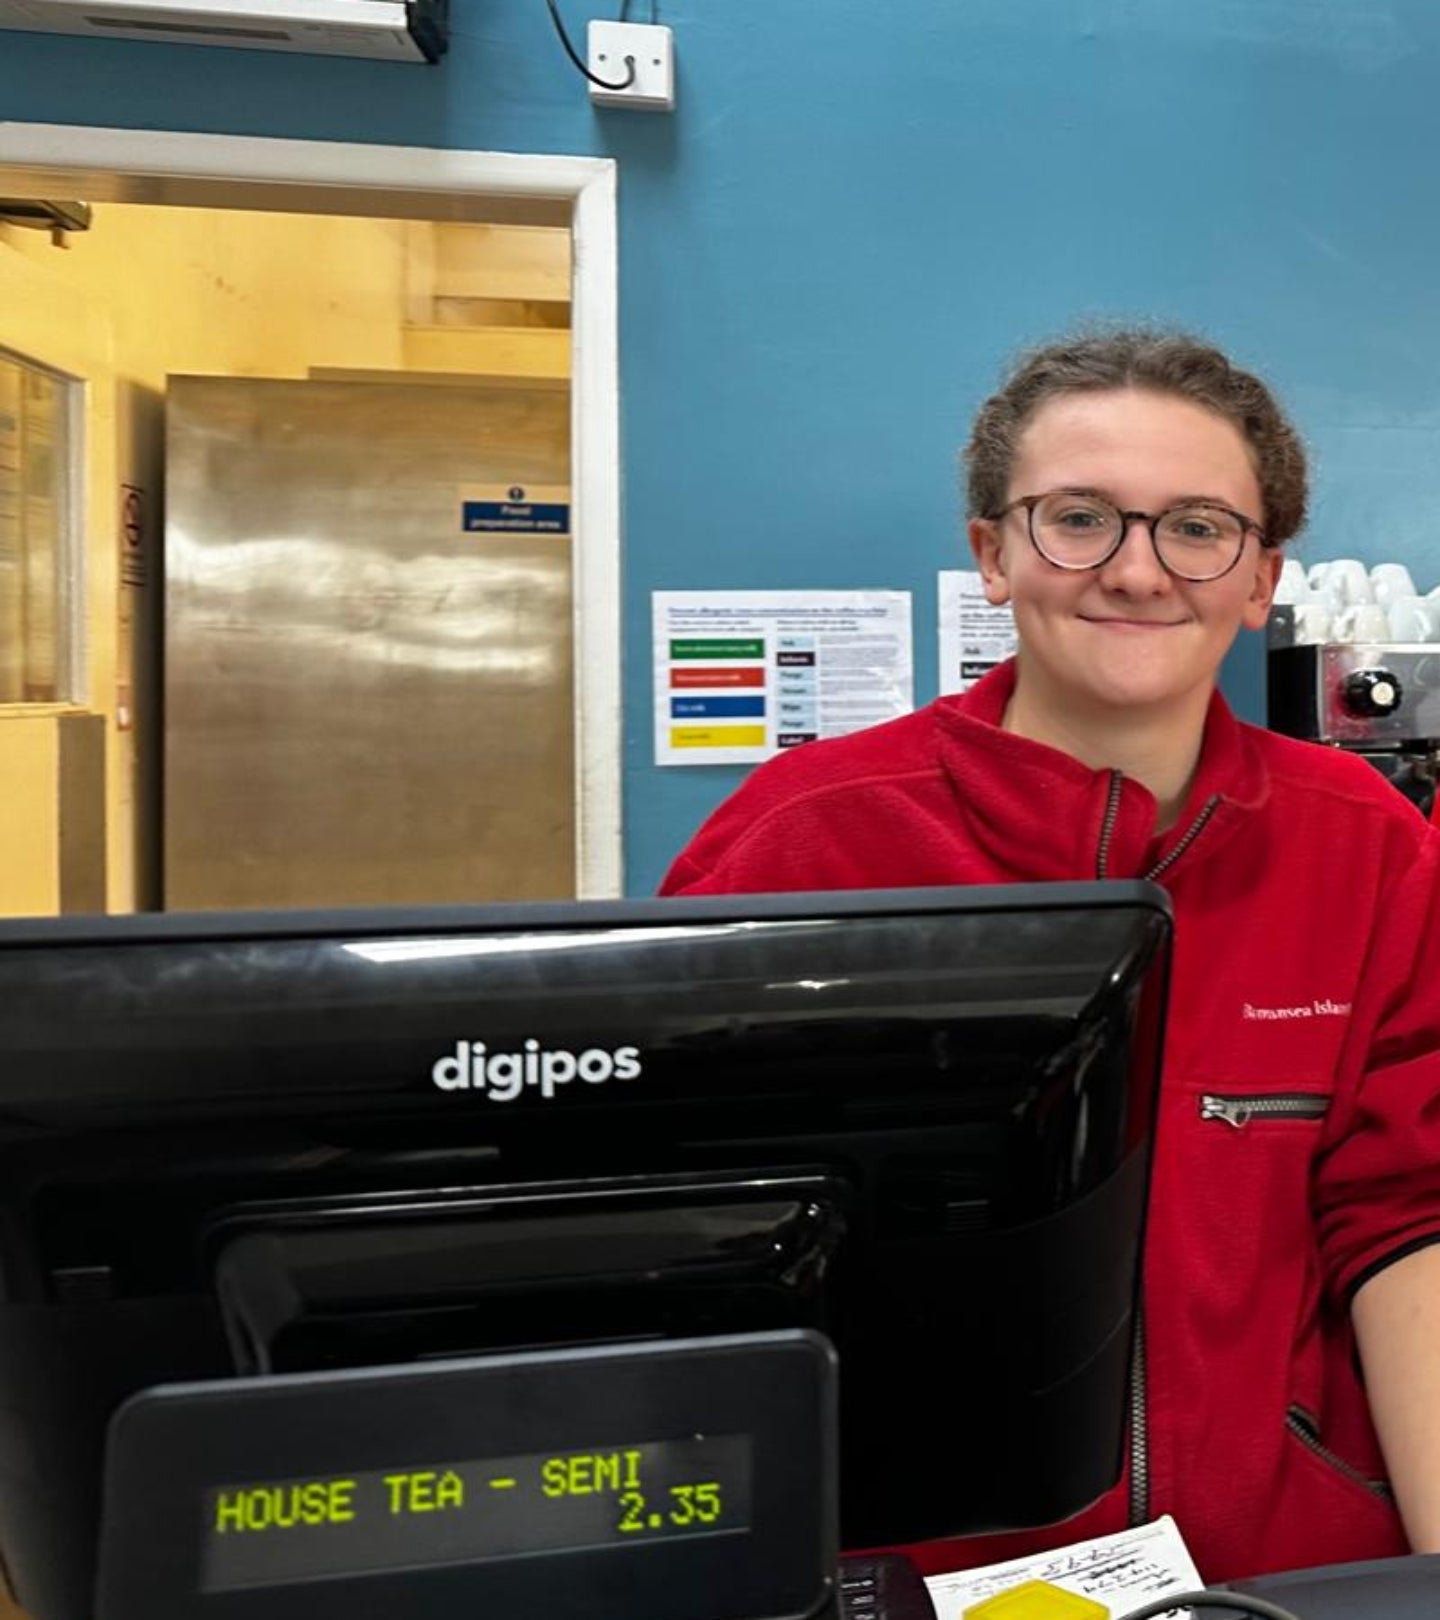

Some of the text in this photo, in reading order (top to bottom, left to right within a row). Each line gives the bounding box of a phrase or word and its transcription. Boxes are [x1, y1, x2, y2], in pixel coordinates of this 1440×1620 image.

[432, 1039, 642, 1101] digipos
[216, 1480, 357, 1533] HOUSE
[385, 1471, 463, 1514] TEA
[542, 1451, 643, 1497] SEMI
[618, 1483, 721, 1531] 2.35
